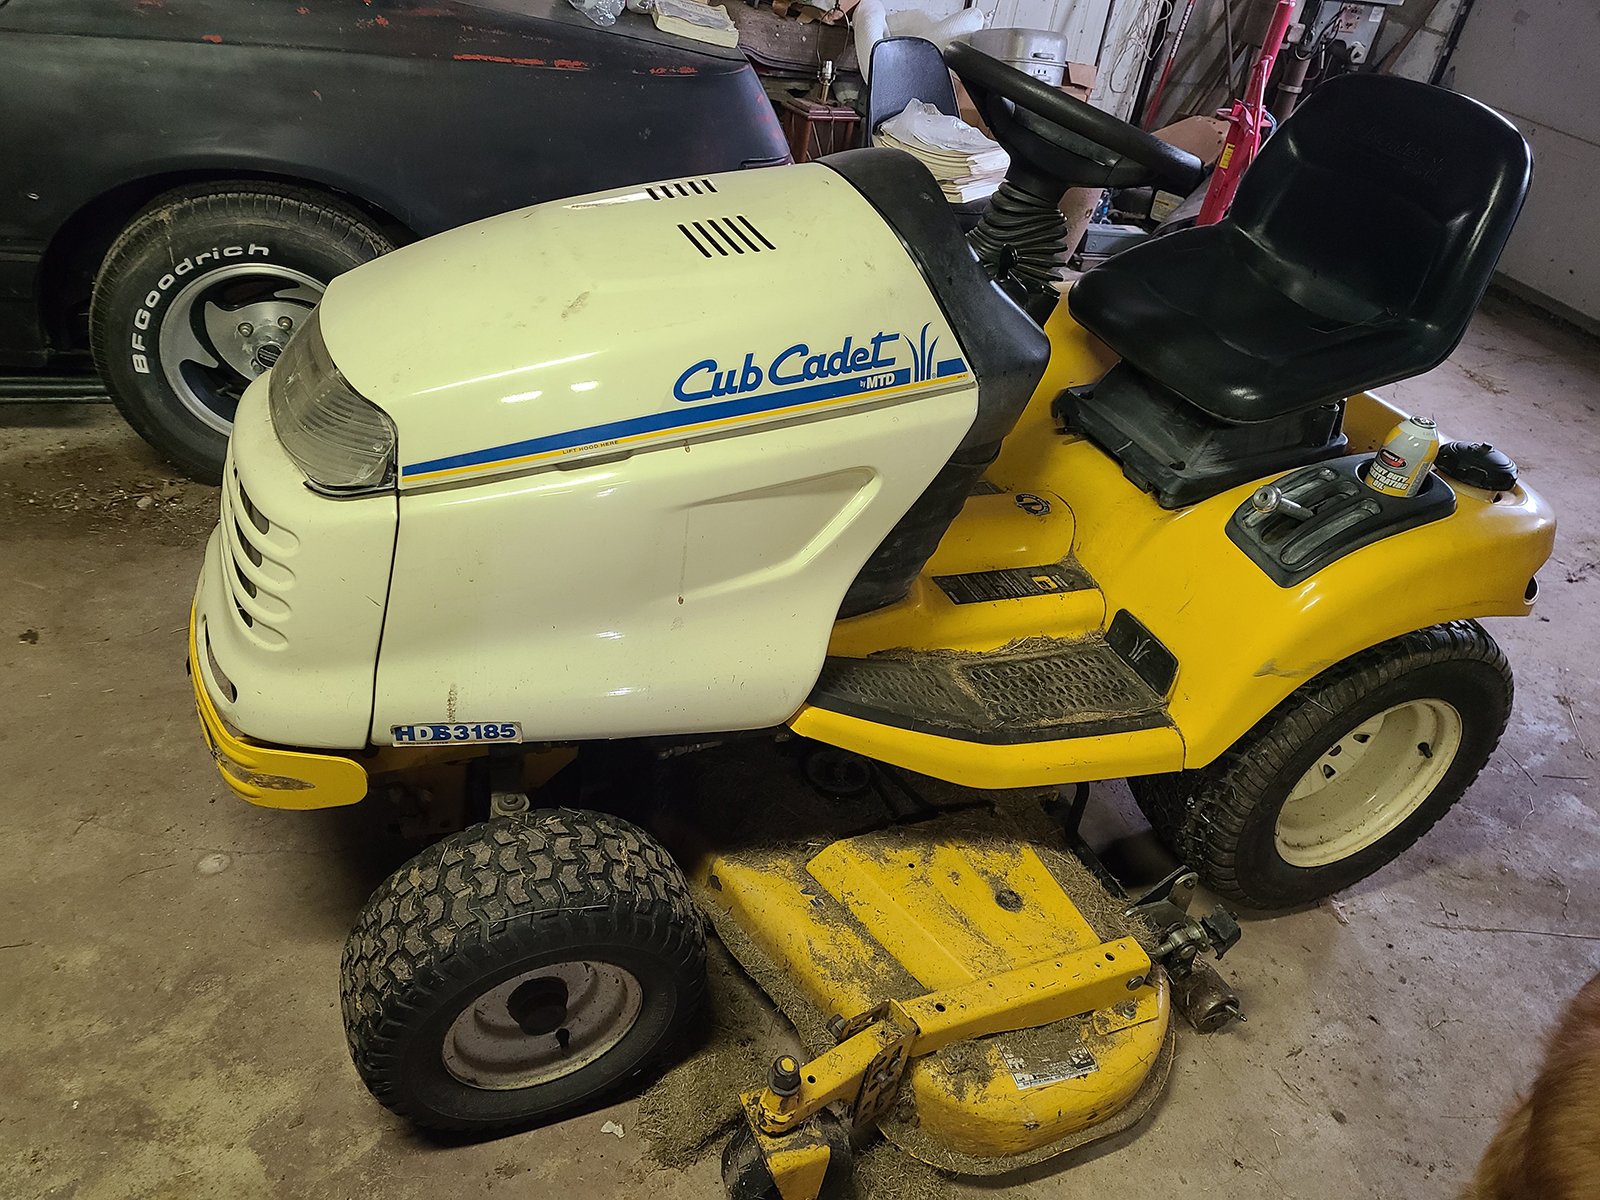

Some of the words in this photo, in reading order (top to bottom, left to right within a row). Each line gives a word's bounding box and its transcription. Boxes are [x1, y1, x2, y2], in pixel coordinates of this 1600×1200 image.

[130, 243, 270, 374] BFGoodrich
[672, 352, 763, 402] Cub
[768, 331, 900, 385] Cadet
[866, 373, 896, 389] MTD
[579, 443, 599, 451] HOOD
[600, 440, 619, 448] HERE
[1386, 470, 1410, 483] DUTY
[1372, 479, 1385, 491] OIL
